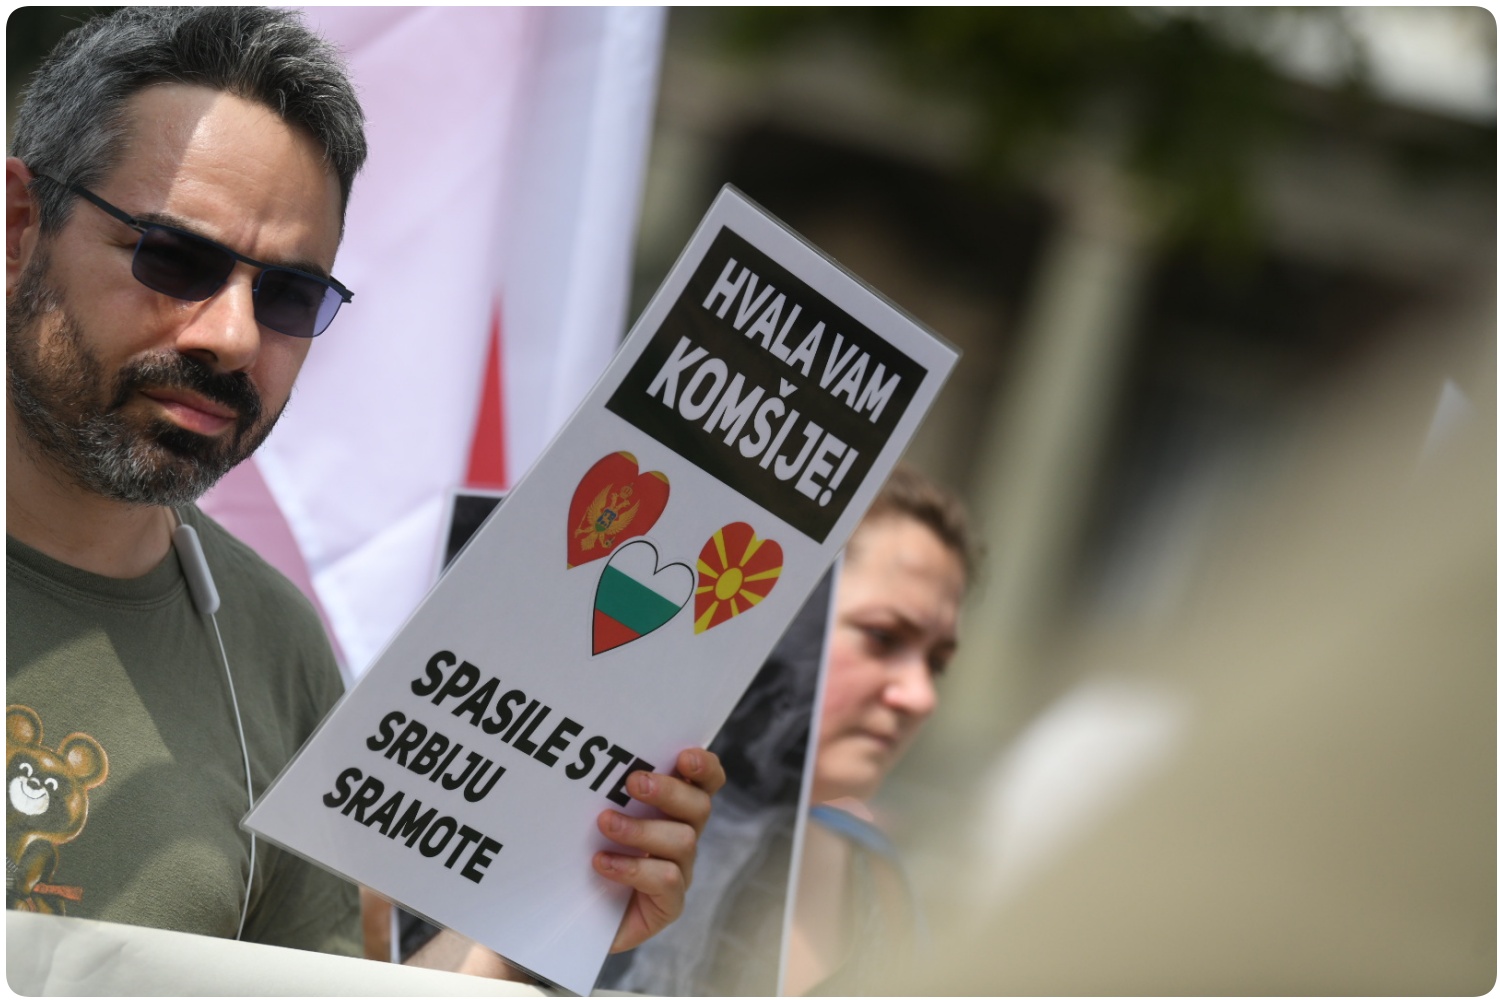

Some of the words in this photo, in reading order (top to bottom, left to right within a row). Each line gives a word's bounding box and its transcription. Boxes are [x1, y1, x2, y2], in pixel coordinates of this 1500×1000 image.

[702, 257, 826, 377] HVALA
[818, 333, 902, 424] VAM
[645, 335, 860, 507] KOMŠIJE!
[365, 710, 507, 804] SRBIJU
[410, 649, 585, 768] SPASILE
[564, 735, 656, 808] STE
[322, 766, 504, 885] SRAMOTE
